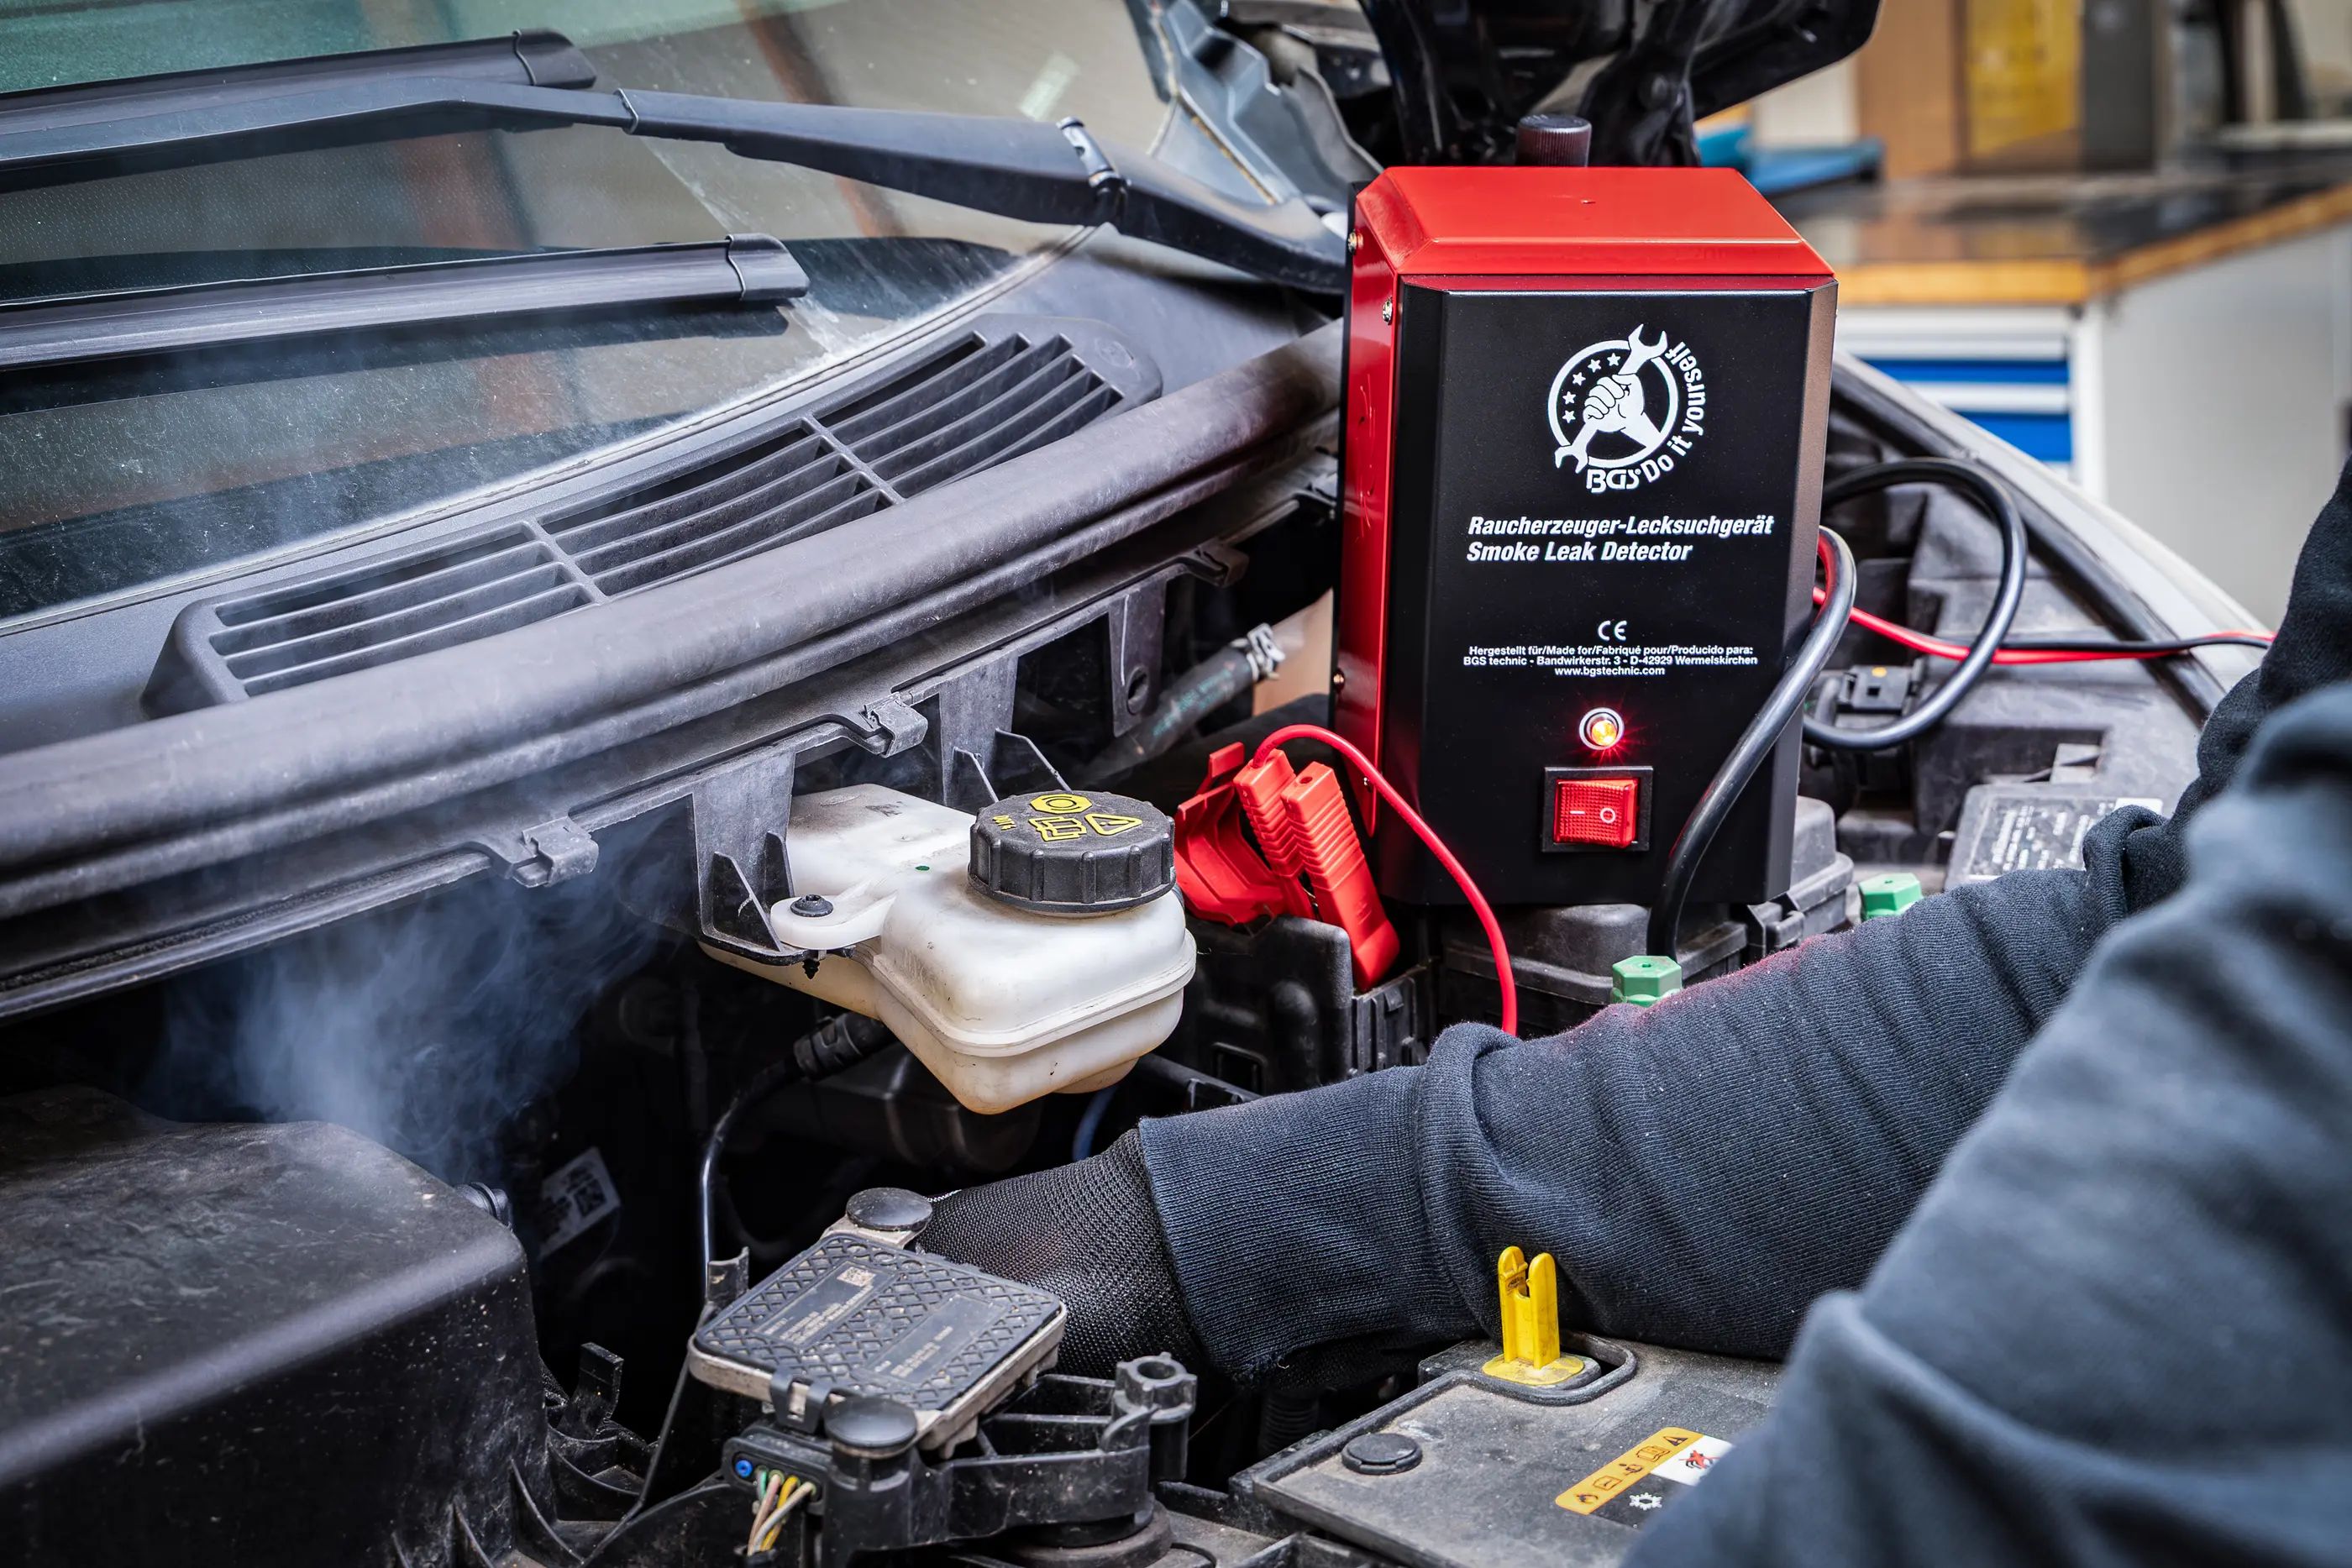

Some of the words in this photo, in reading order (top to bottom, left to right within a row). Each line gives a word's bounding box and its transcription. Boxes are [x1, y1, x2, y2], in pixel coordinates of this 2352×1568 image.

[1664, 341, 1706, 437] yourself
[1666, 435, 1693, 457] it
[1640, 454, 1675, 483] Do
[1467, 515, 1775, 539] Raucherzeuger-Lecksuchgerät
[1466, 541, 1541, 562] Smoke
[1544, 541, 1598, 561] Leak
[1600, 541, 1693, 561] Detector
[1597, 620, 1628, 642] CE
[1463, 656, 1487, 666] BGS
[1488, 656, 1528, 666] technic
[1536, 656, 1612, 666] Bandwirkerstr.
[1613, 655, 1621, 665] 3
[1630, 655, 1673, 665] D-42929
[1675, 655, 1759, 666] Wermelskirchen
[1469, 646, 1526, 658] Hergestellt
[1528, 645, 1576, 656] für/Made
[1577, 645, 1641, 657] for/Fabriqué
[1642, 645, 1725, 657] pour/Producido
[1725, 646, 1754, 657] para:
[1554, 666, 1666, 677] www.bgstechnic.com
